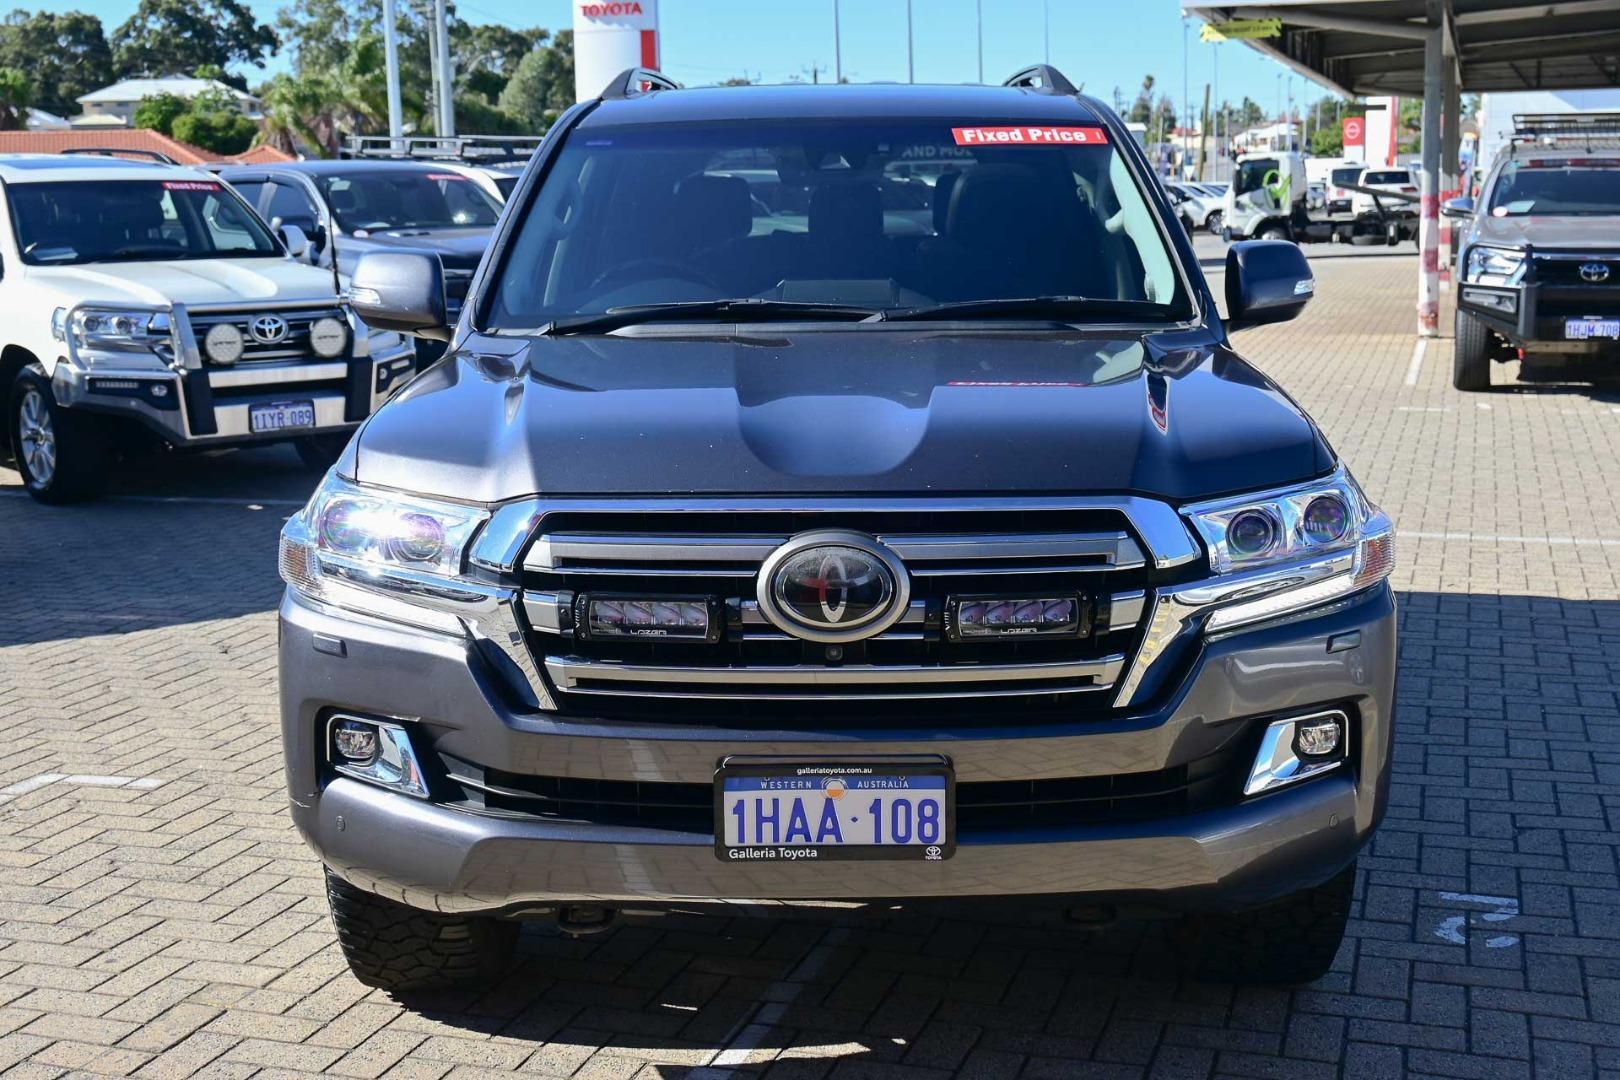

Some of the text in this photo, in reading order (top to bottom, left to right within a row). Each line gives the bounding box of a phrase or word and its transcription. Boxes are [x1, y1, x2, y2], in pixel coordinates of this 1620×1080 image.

[581, 2, 642, 17] TOYOTA
[962, 128, 1023, 143] Fixed
[1027, 128, 1087, 142] Price
[902, 145, 937, 158] AND
[797, 767, 872, 775] galleriatoyota.com.au
[760, 780, 909, 789] WESTERN AUSTRALIA
[729, 848, 818, 861] Galleria Toyota
